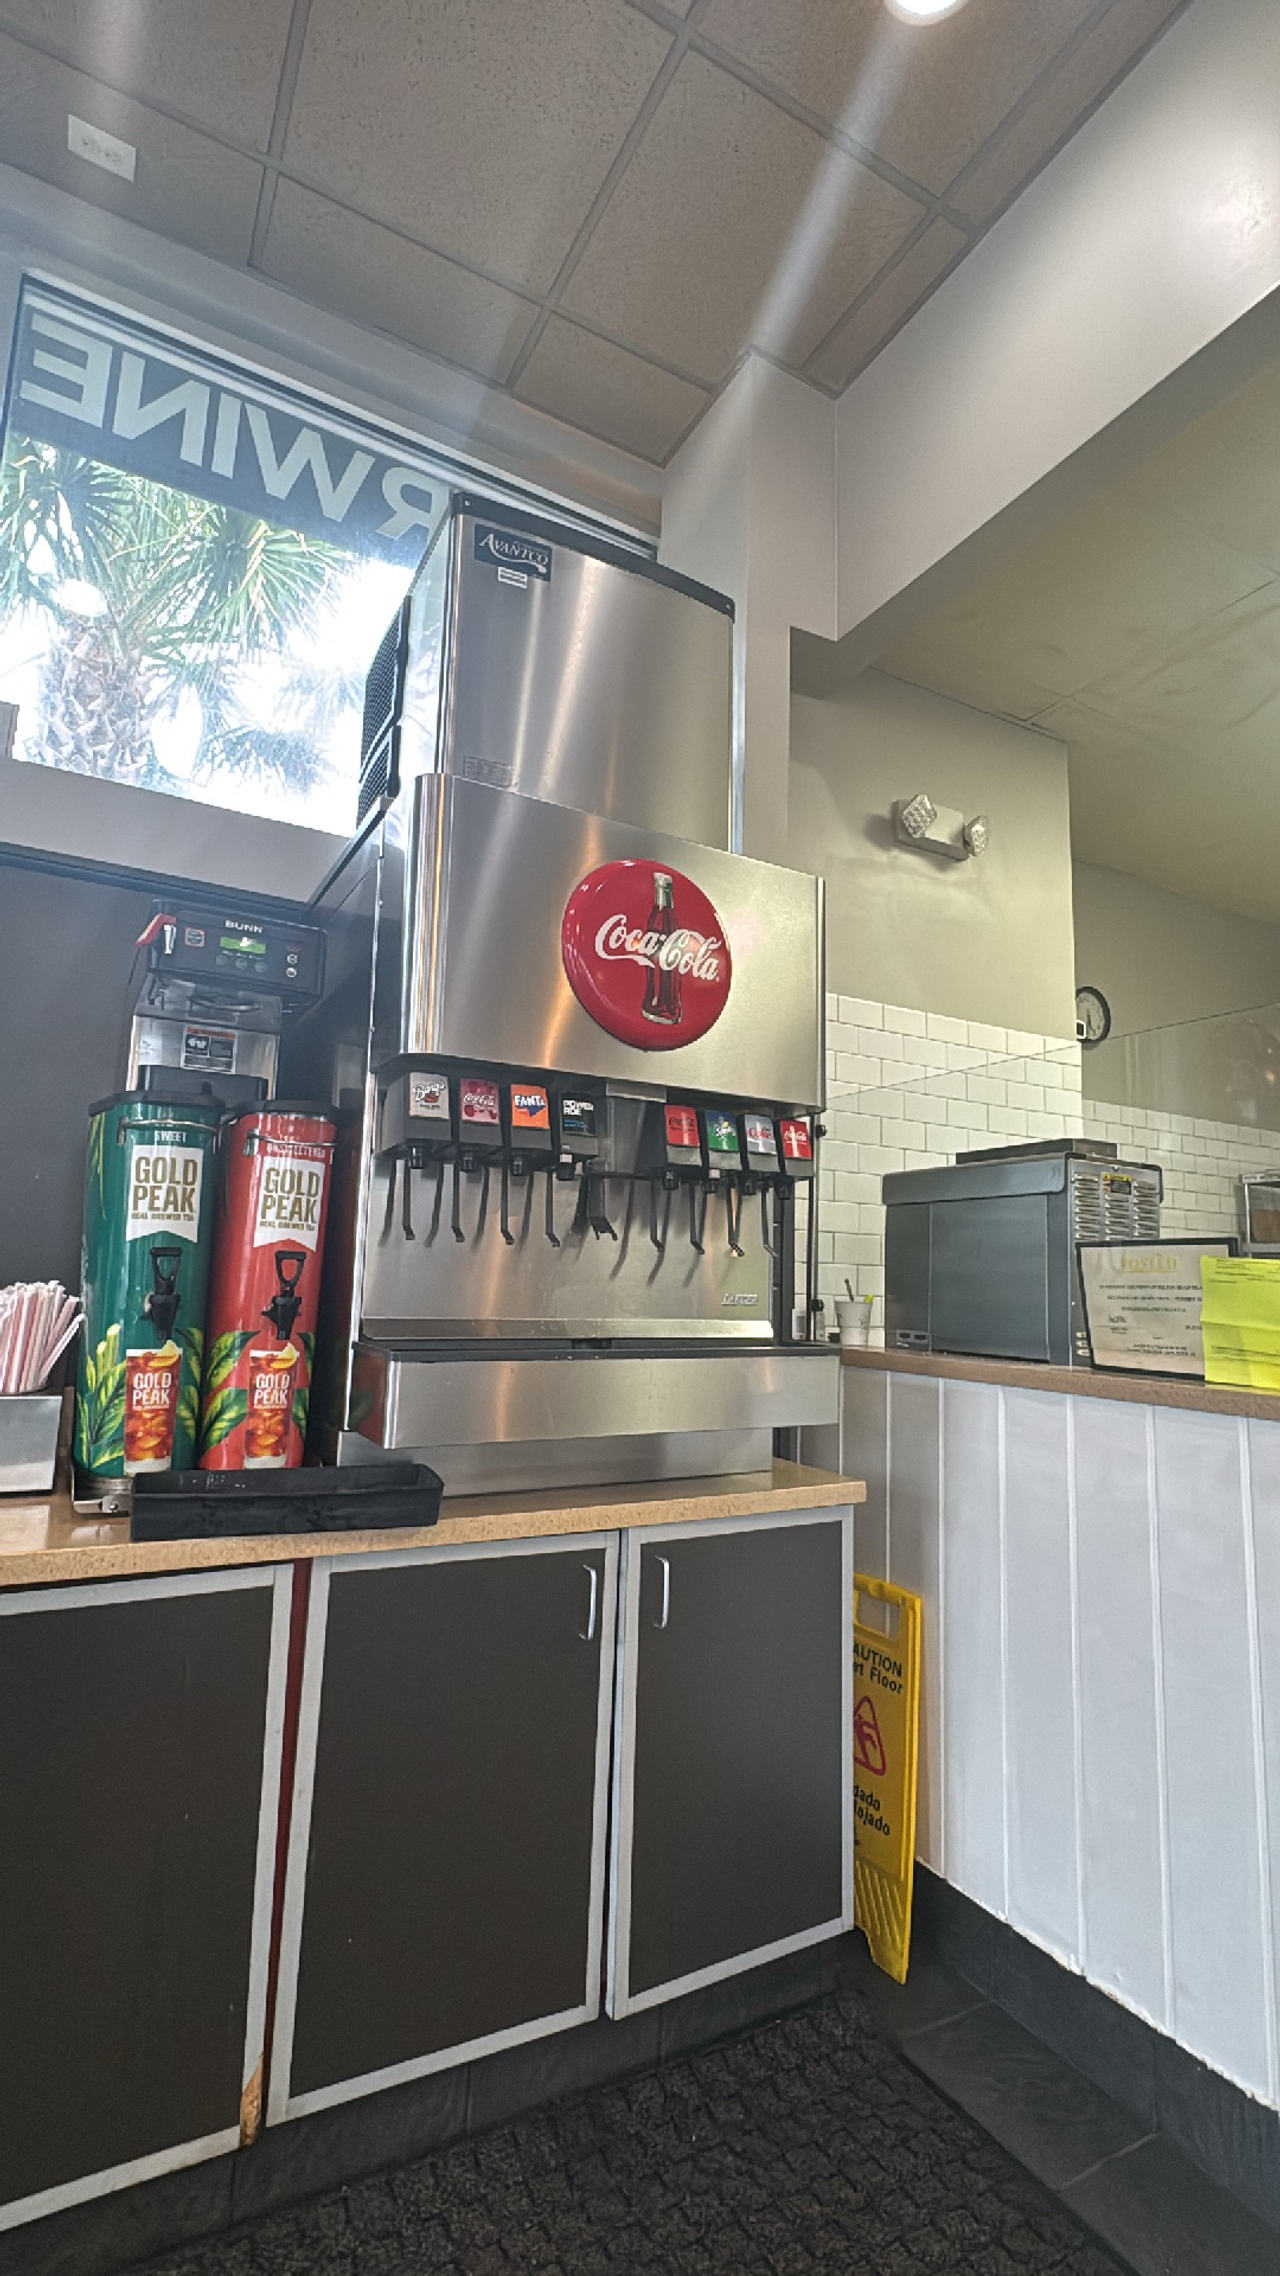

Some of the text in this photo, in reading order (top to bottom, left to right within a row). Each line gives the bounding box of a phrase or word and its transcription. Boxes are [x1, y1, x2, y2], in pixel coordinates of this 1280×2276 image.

[225, 919, 263, 934] BUNN
[595, 914, 722, 981] Coca-Cola
[154, 1130, 187, 1143] SWEET
[135, 1156, 198, 1186] GOLD
[264, 1167, 320, 1197] GOLD
[132, 1185, 196, 1213] PEAK
[260, 1194, 318, 1223] PEAK
[133, 1372, 172, 1389] GOLD
[255, 1373, 291, 1389] GOLD
[132, 1389, 170, 1405] PEAK
[253, 1389, 288, 1405] PEAK
[853, 1643, 903, 1678] AUTION
[870, 1666, 902, 1694] Floor
[853, 1784, 881, 1811] dado
